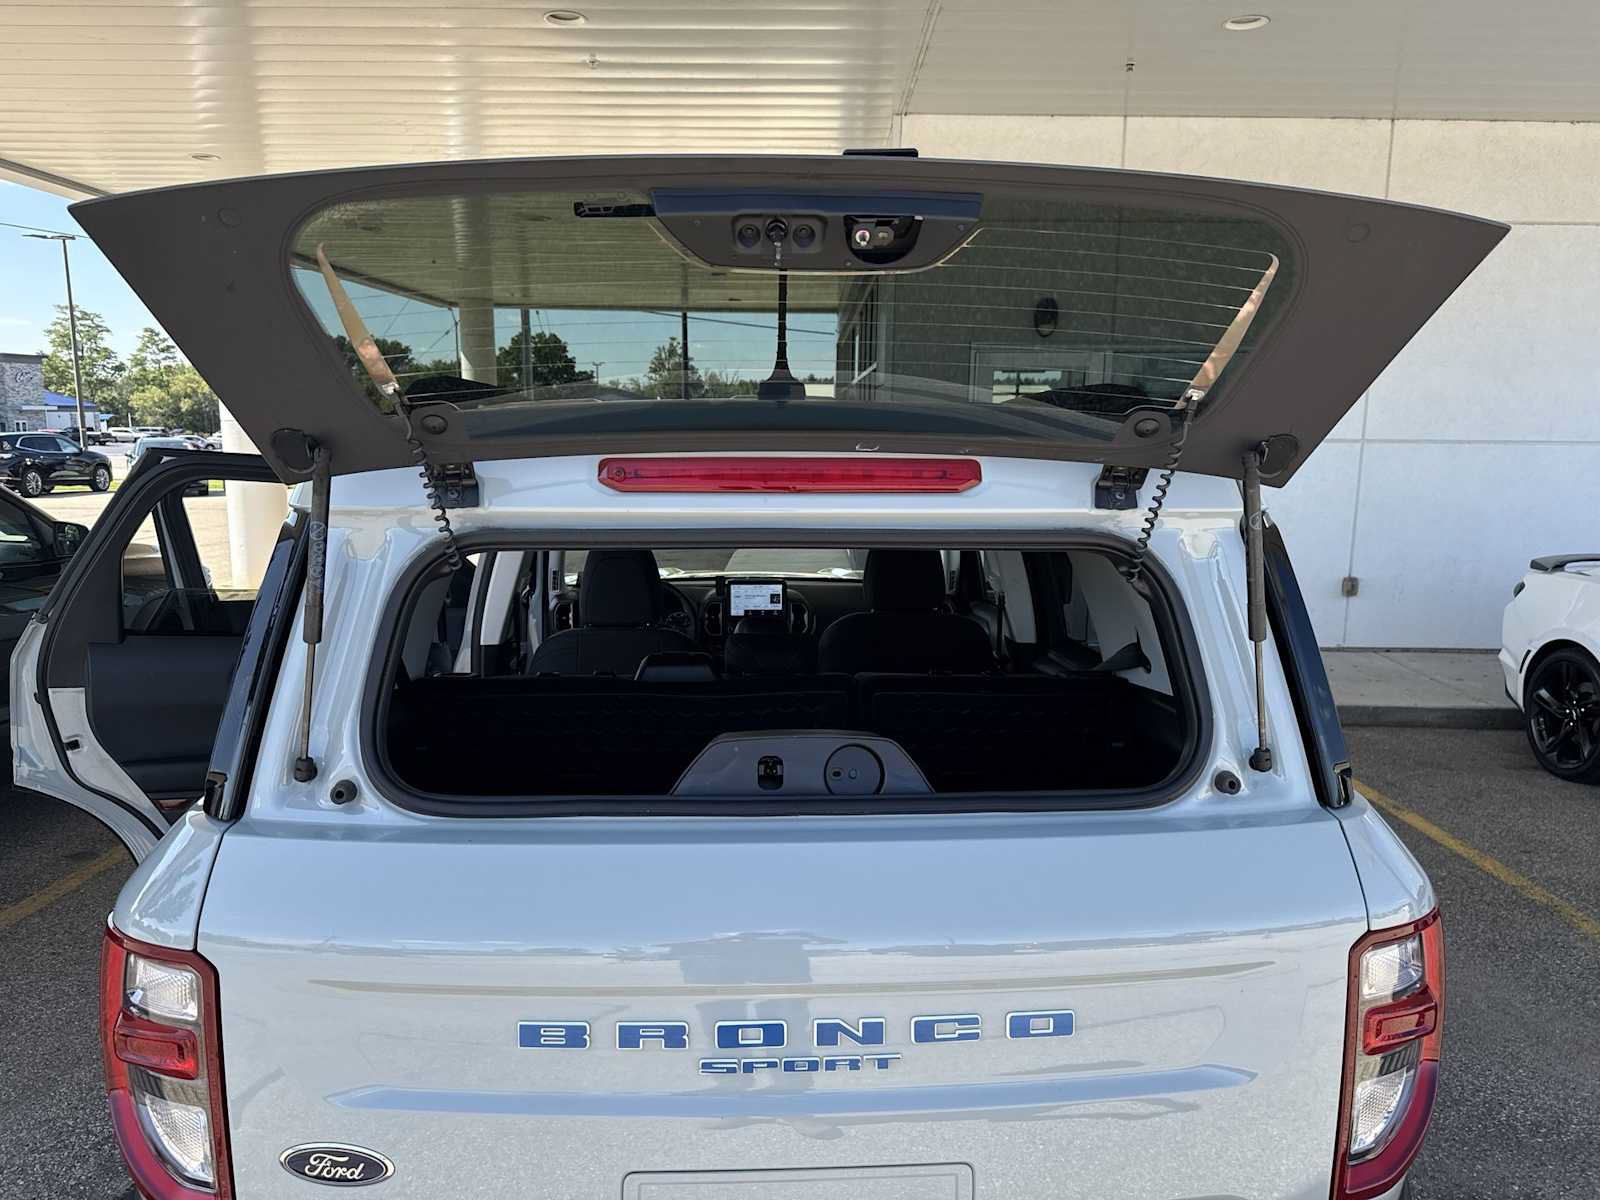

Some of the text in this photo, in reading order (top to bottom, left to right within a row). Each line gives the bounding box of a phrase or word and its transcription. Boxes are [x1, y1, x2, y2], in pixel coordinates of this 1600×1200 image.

[517, 1009, 1076, 1050] BRONCO
[699, 1053, 902, 1075] SPORT
[304, 1153, 365, 1180] Ford
